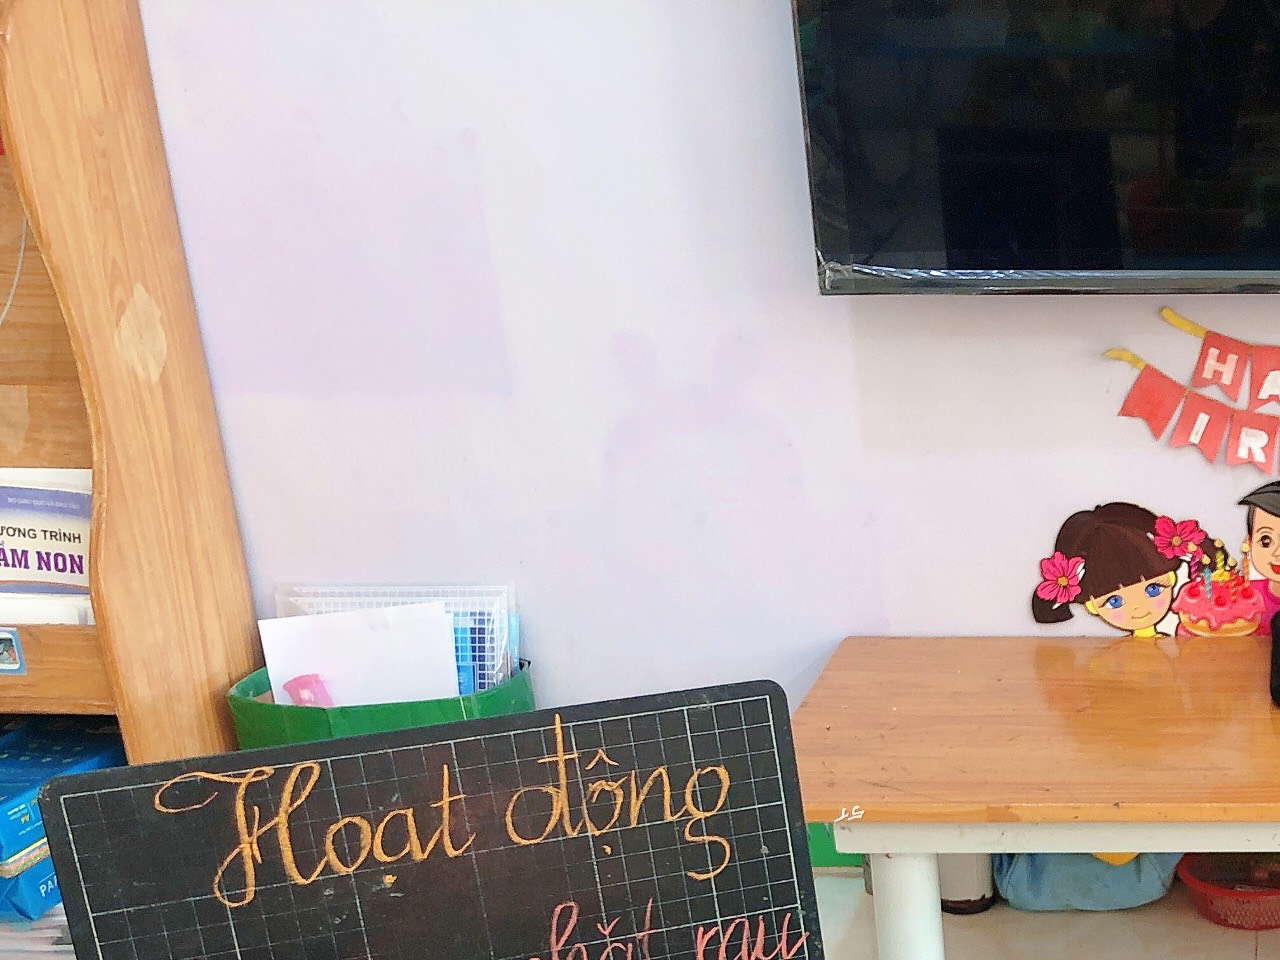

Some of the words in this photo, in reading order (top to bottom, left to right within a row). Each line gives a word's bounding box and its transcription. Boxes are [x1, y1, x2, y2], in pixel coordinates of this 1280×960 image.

[41, 529, 82, 544] TRÌNH
[36, 550, 85, 575] NON
[154, 761, 477, 908] Hoạt
[505, 713, 732, 881] động
